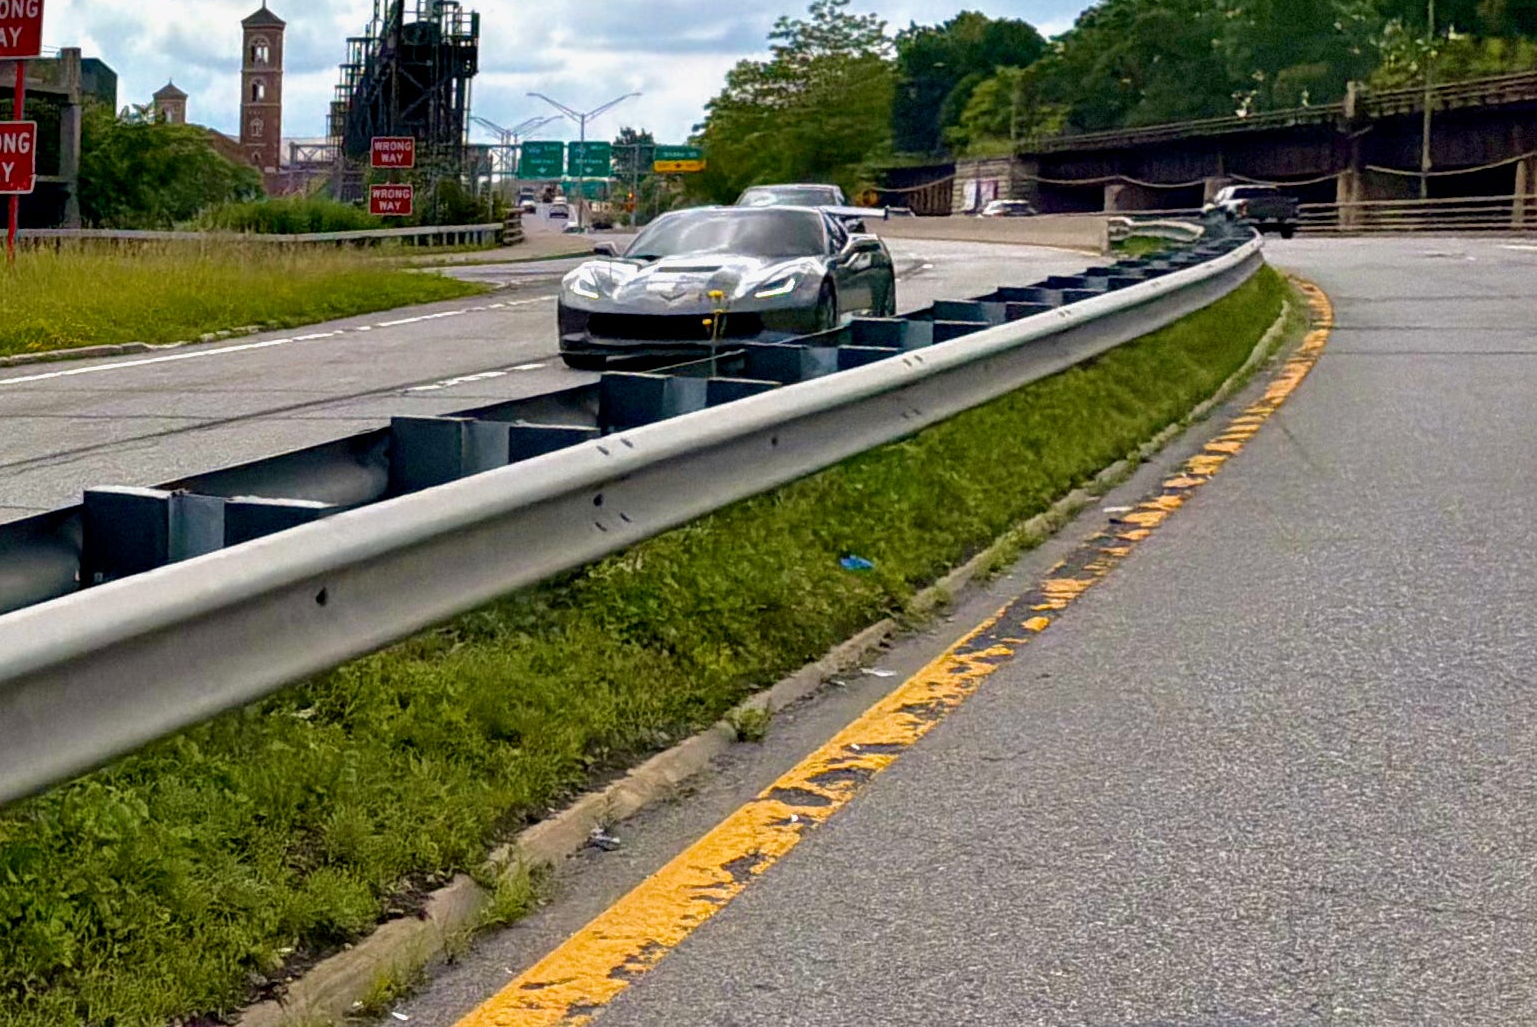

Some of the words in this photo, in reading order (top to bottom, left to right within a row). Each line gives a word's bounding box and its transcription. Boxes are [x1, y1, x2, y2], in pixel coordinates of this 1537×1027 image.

[374, 141, 412, 151] WRONG
[381, 153, 403, 163] WAY
[372, 189, 411, 199] WRONG
[378, 201, 402, 211] WAY
